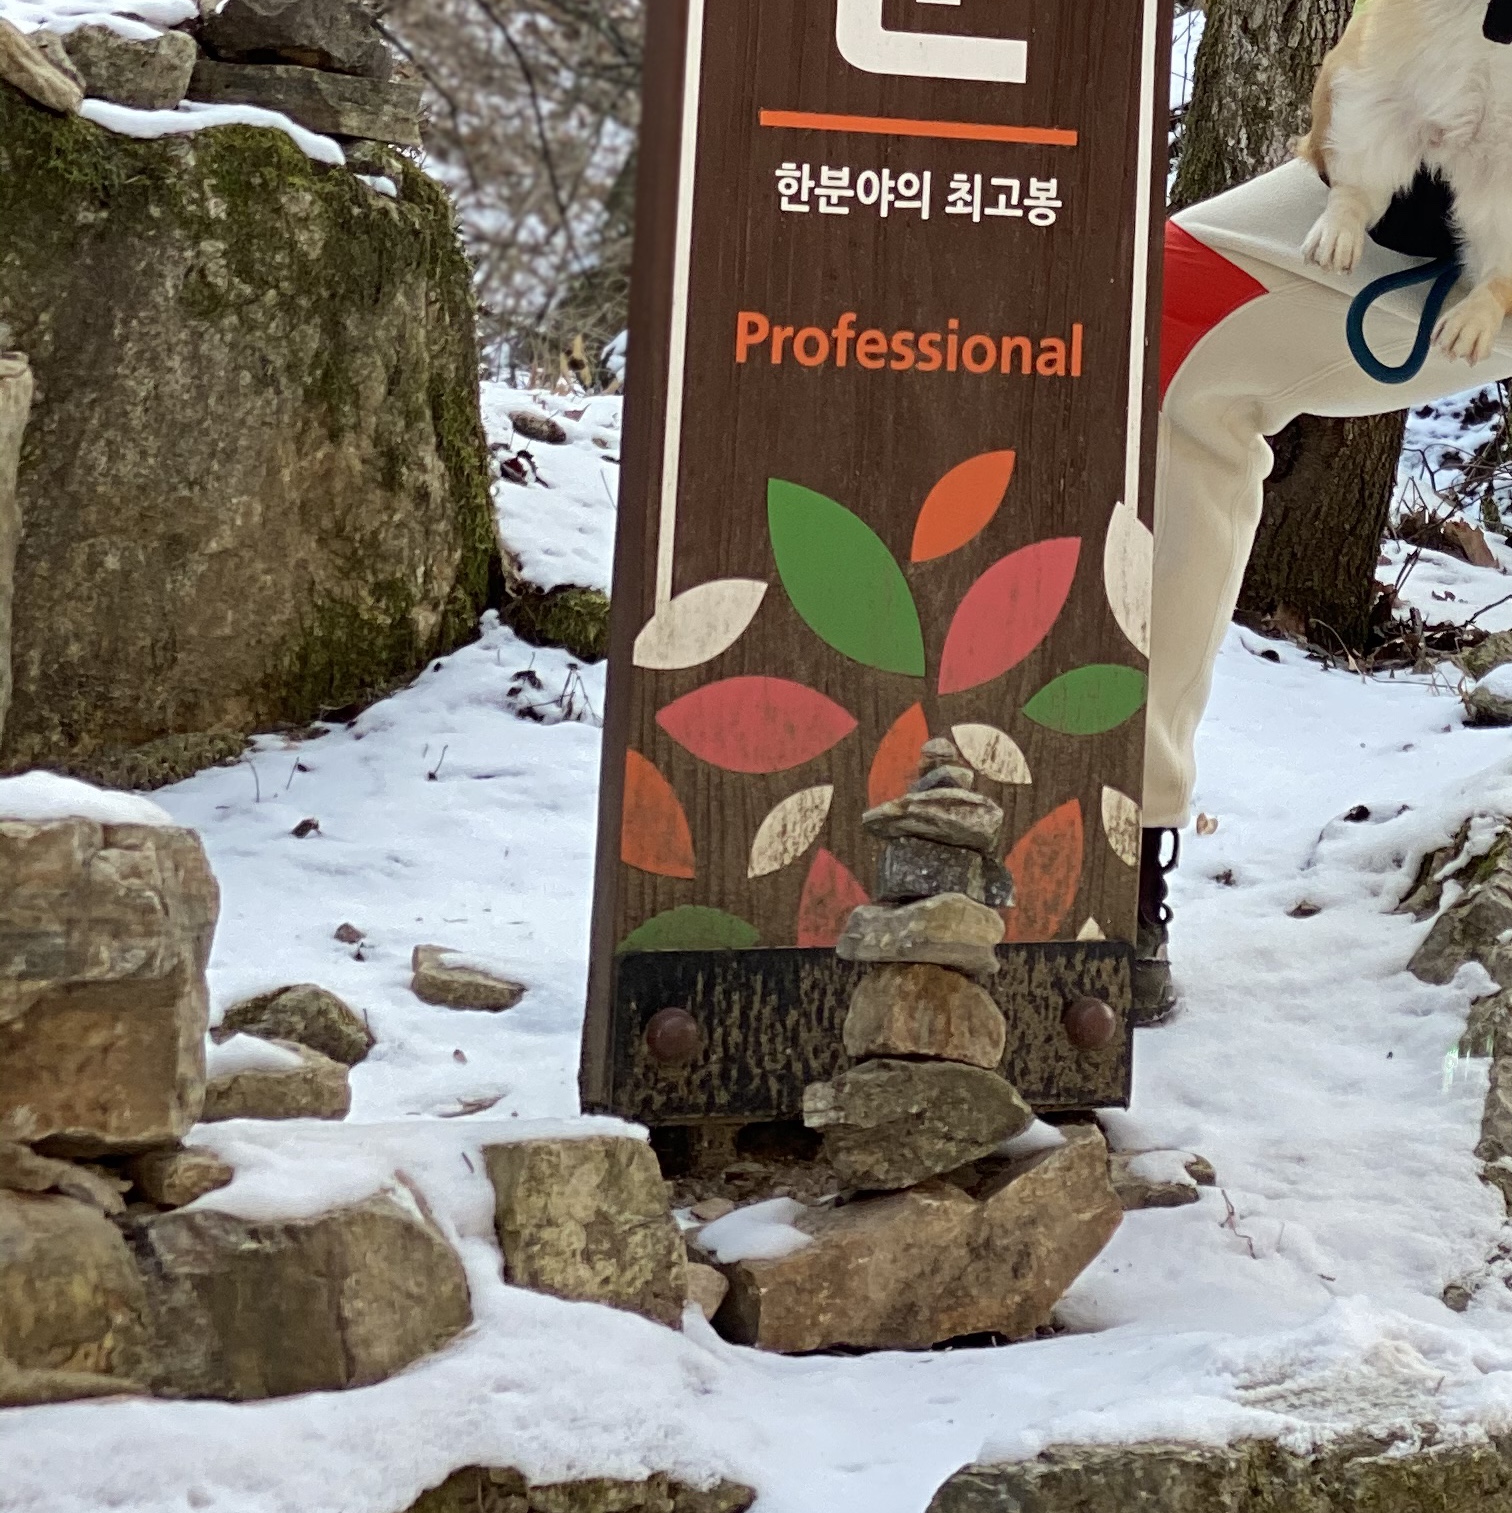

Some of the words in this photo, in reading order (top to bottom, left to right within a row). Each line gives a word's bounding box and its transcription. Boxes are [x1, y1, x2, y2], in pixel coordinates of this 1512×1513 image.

[775, 162, 931, 220] 한분야의
[944, 172, 1063, 227] 최고봉
[736, 310, 1083, 377] Professional
